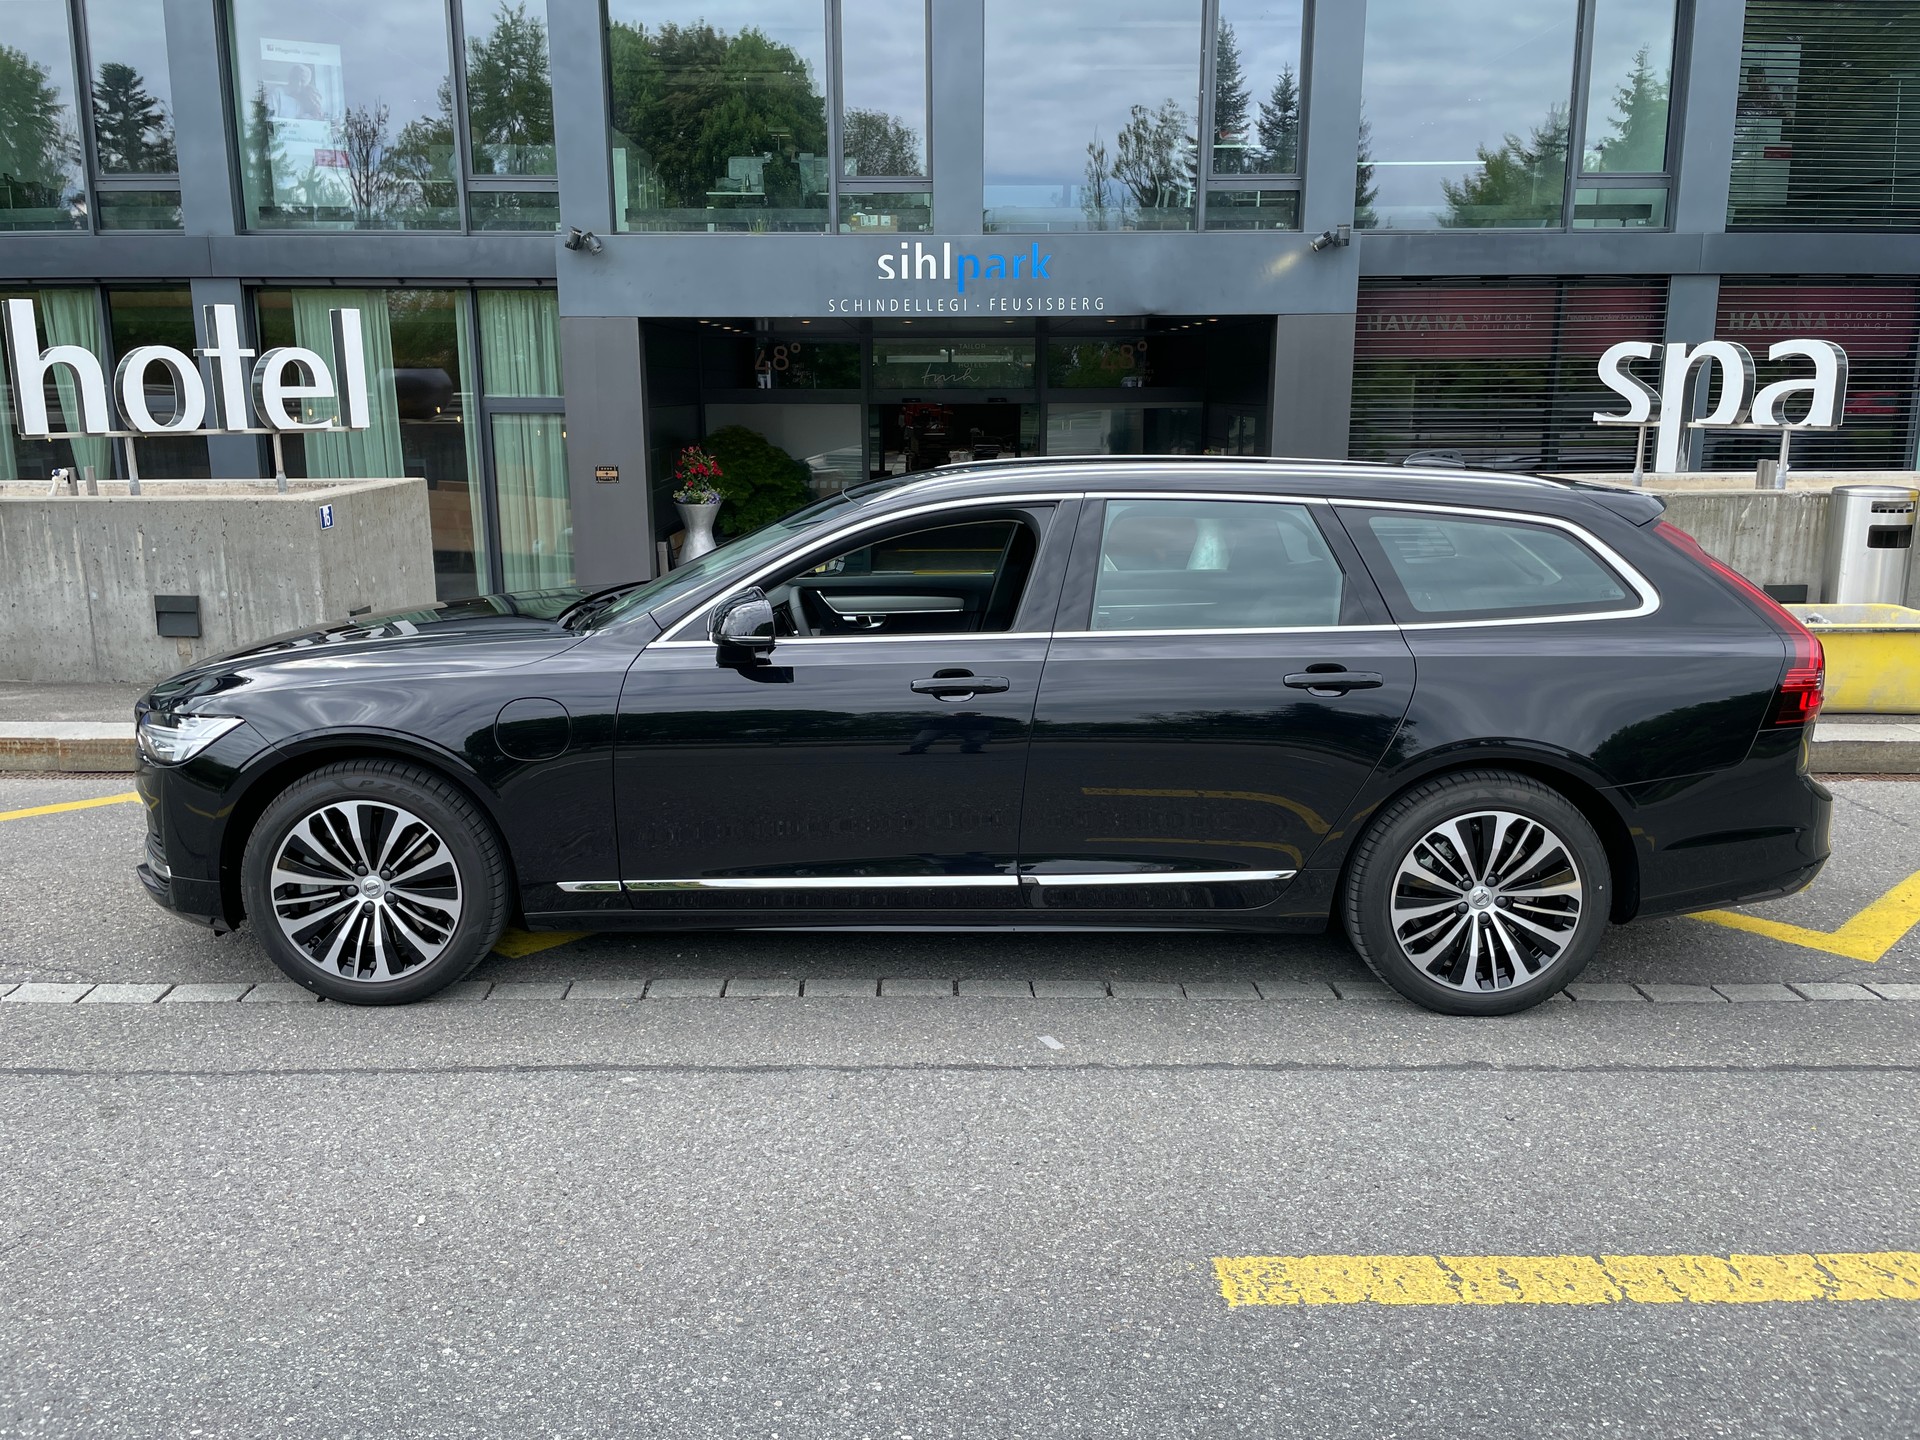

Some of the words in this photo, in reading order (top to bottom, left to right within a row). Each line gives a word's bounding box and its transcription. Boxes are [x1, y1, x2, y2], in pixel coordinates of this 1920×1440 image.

[877, 242, 1052, 294] sihlpark
[828, 299, 967, 312] SCHINDELLEGI
[989, 298, 1104, 311] FEUSISBERG
[1366, 314, 1467, 331] HAVANA
[1728, 312, 1829, 330] HAVANA
[2, 298, 370, 435] hotel
[1593, 339, 1848, 472] spa
